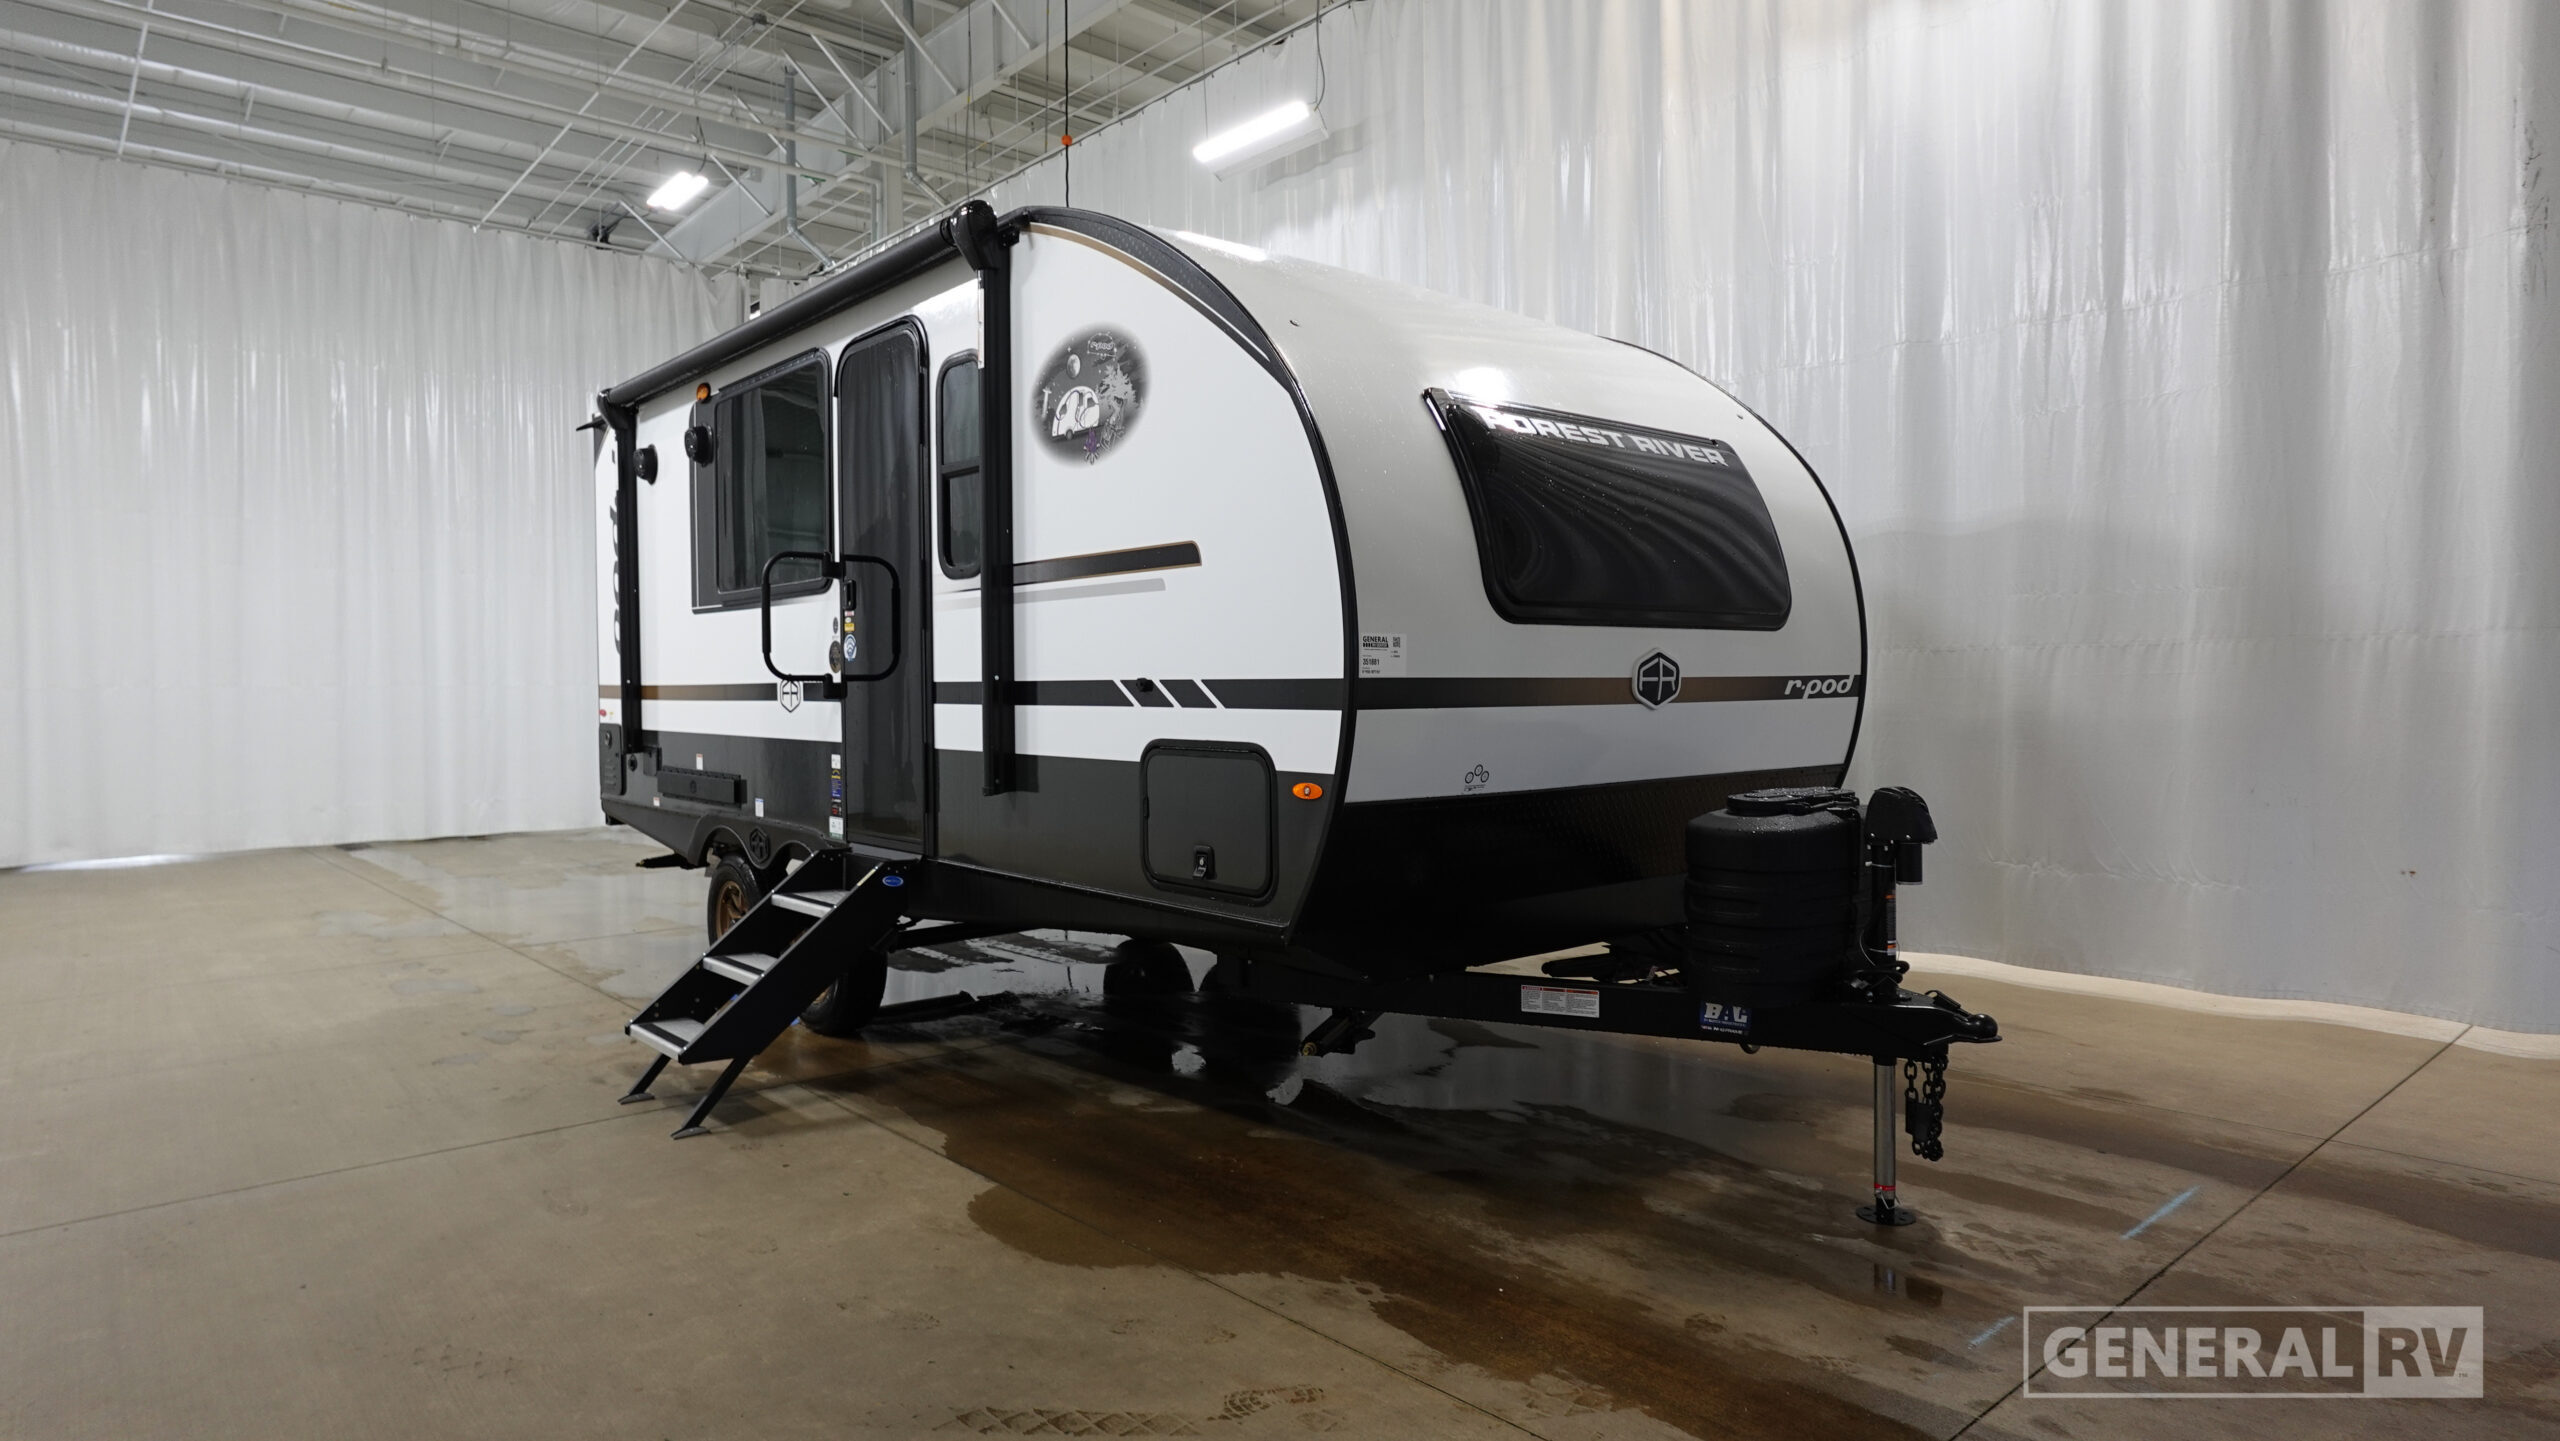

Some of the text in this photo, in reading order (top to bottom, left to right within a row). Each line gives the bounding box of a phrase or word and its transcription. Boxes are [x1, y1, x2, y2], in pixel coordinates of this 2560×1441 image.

[1478, 403, 1728, 467] FOREST RIVER
[1362, 635, 1389, 643] GENERAL
